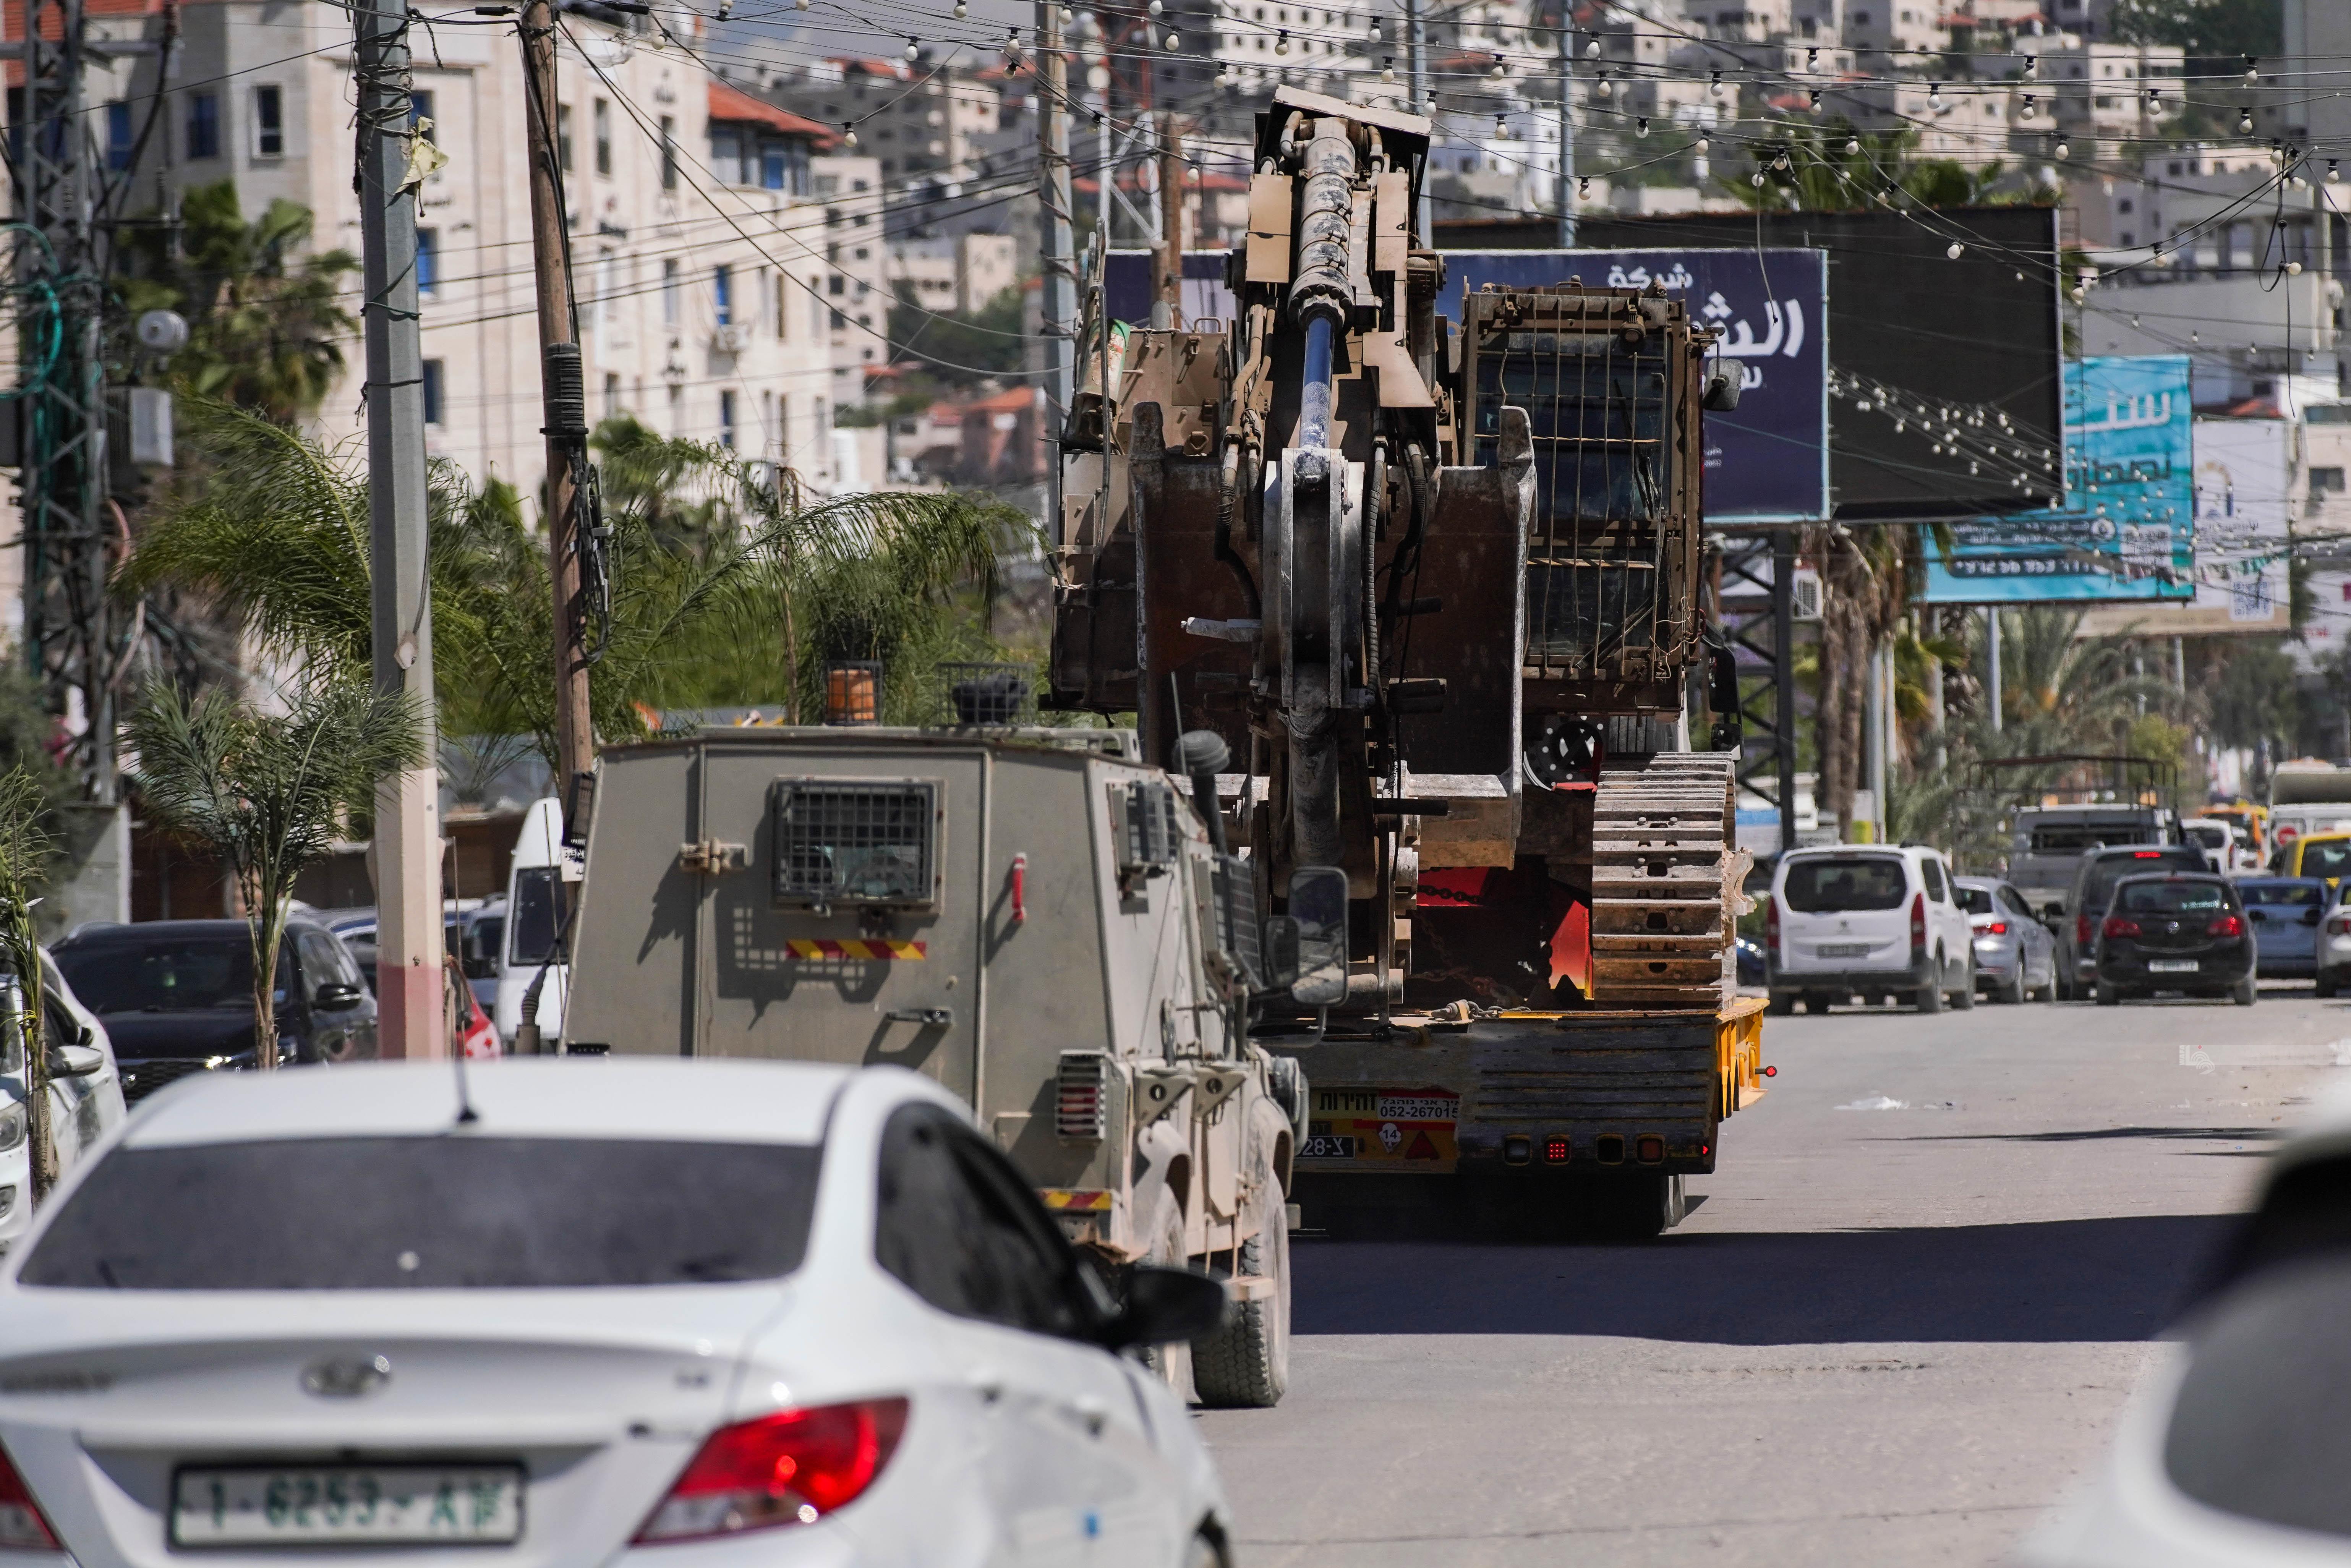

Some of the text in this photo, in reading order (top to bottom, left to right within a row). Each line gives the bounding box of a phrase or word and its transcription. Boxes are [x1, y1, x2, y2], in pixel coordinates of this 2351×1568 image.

[1607, 262, 1693, 290] شركة
[1319, 1093, 1377, 1110] זהירות
[1383, 1129, 1397, 1139] 14
